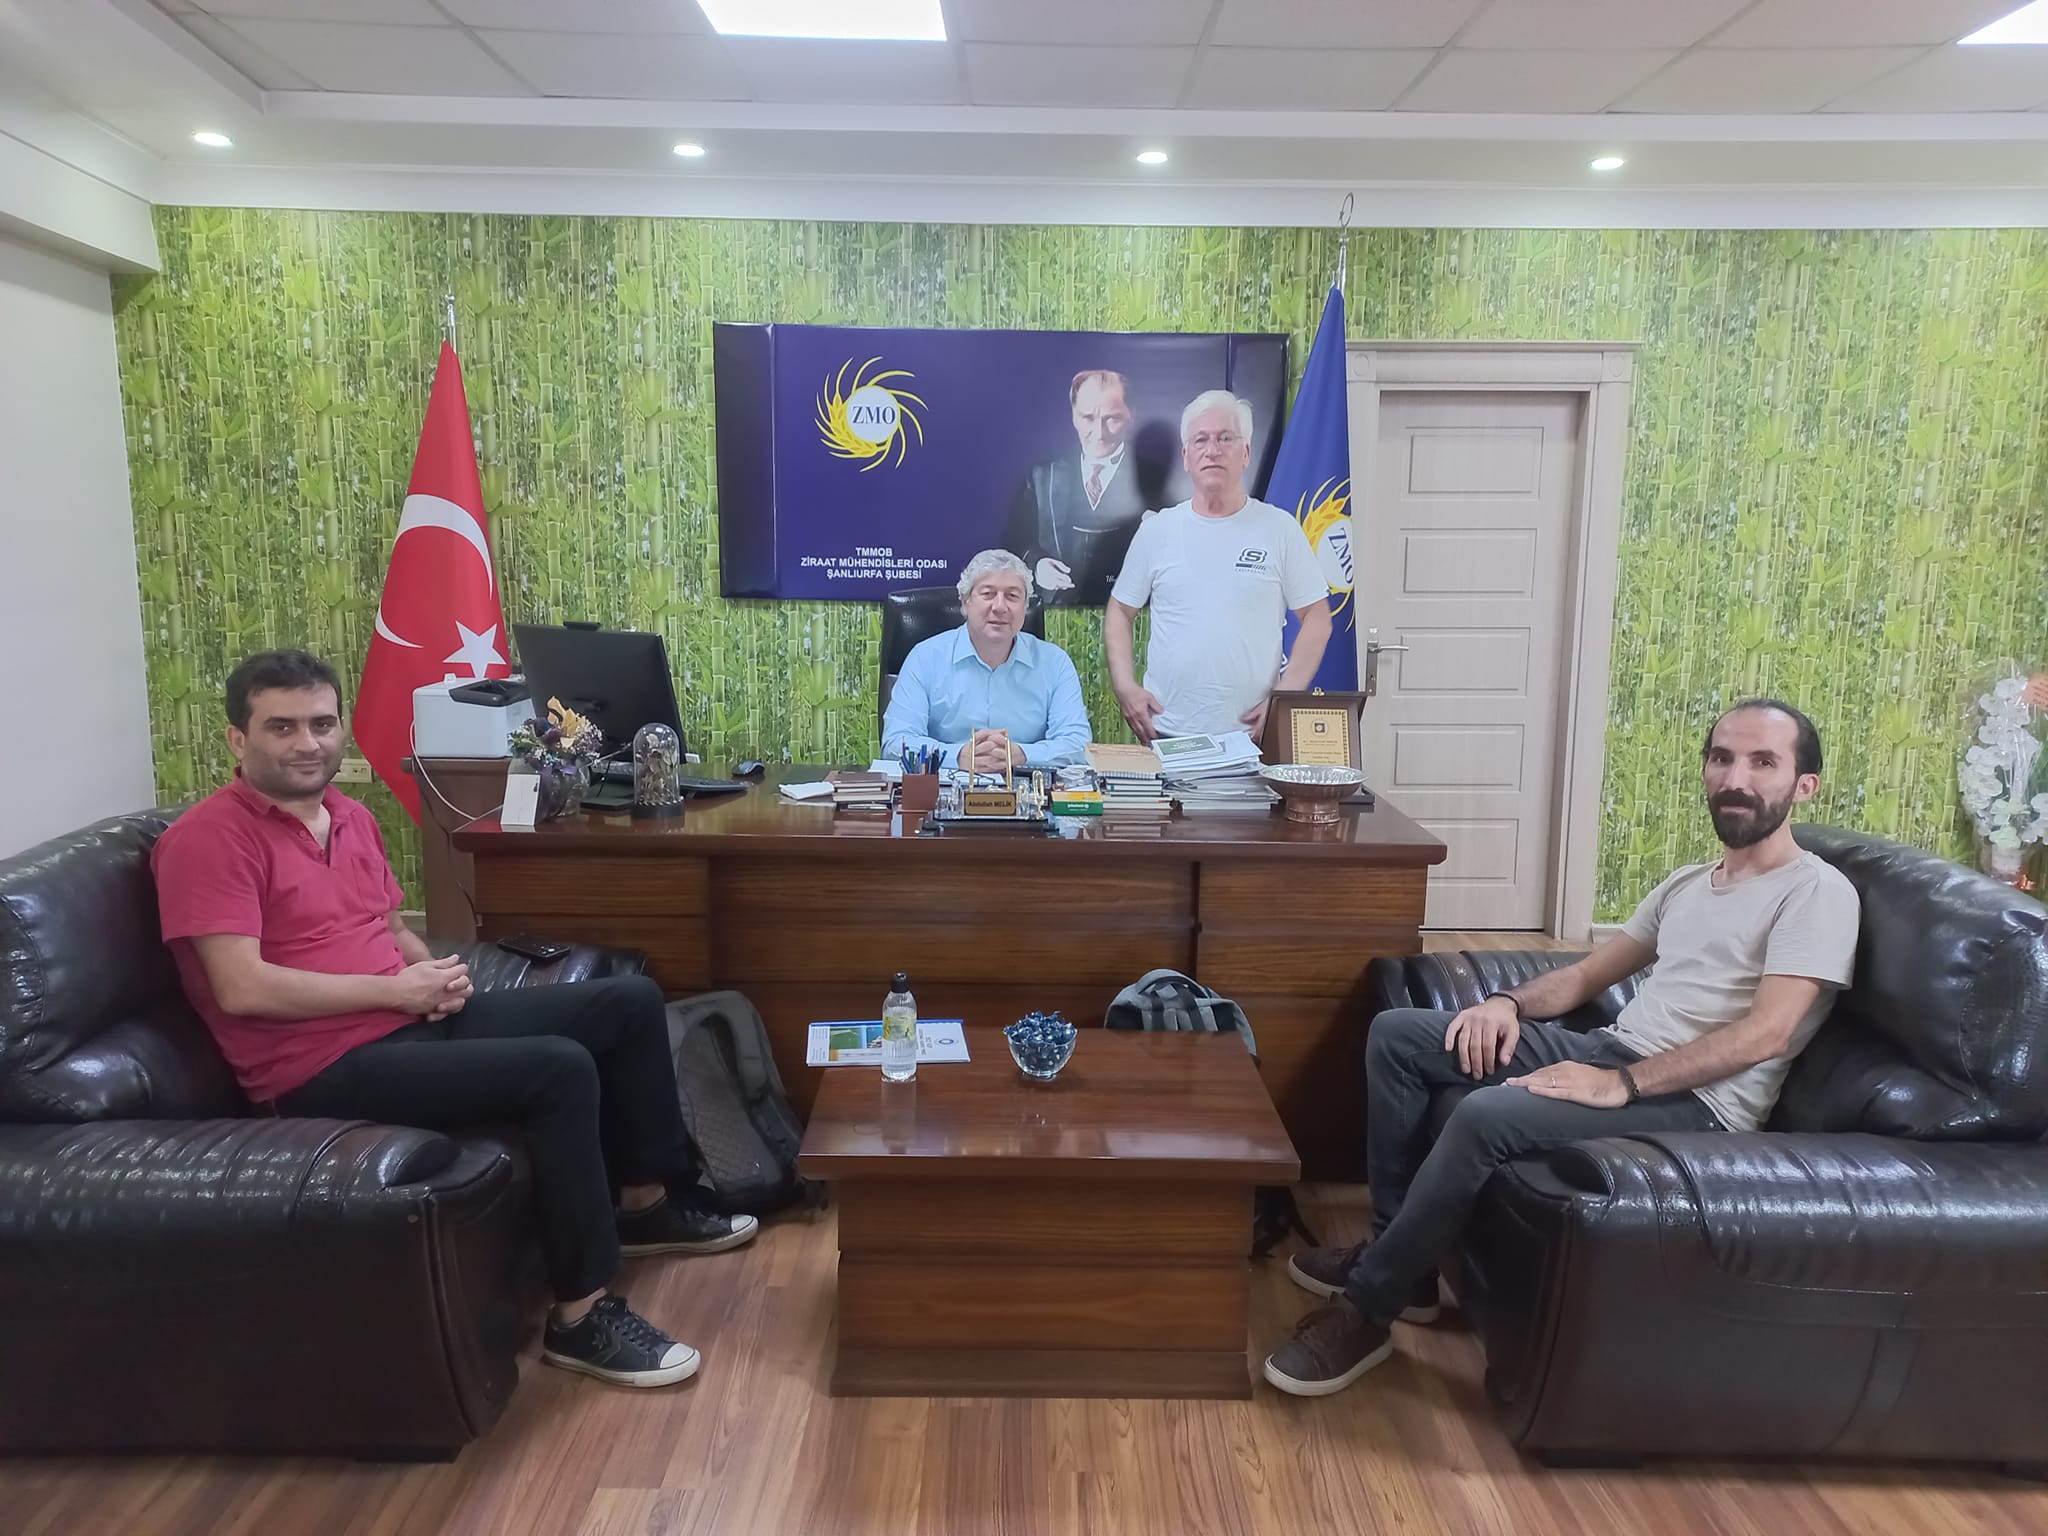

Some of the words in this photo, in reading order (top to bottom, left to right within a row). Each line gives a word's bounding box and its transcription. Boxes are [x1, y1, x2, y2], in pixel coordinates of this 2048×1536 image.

[852, 406, 896, 425] ZMO
[855, 547, 893, 557] TMMOB
[800, 556, 836, 567] ZİRAAT
[839, 557, 914, 568] MÜHENDİSLERİ
[916, 559, 948, 569] ODASI
[826, 568, 883, 580] ŞANLIURFA
[885, 569, 922, 580] ŞUBESİ
